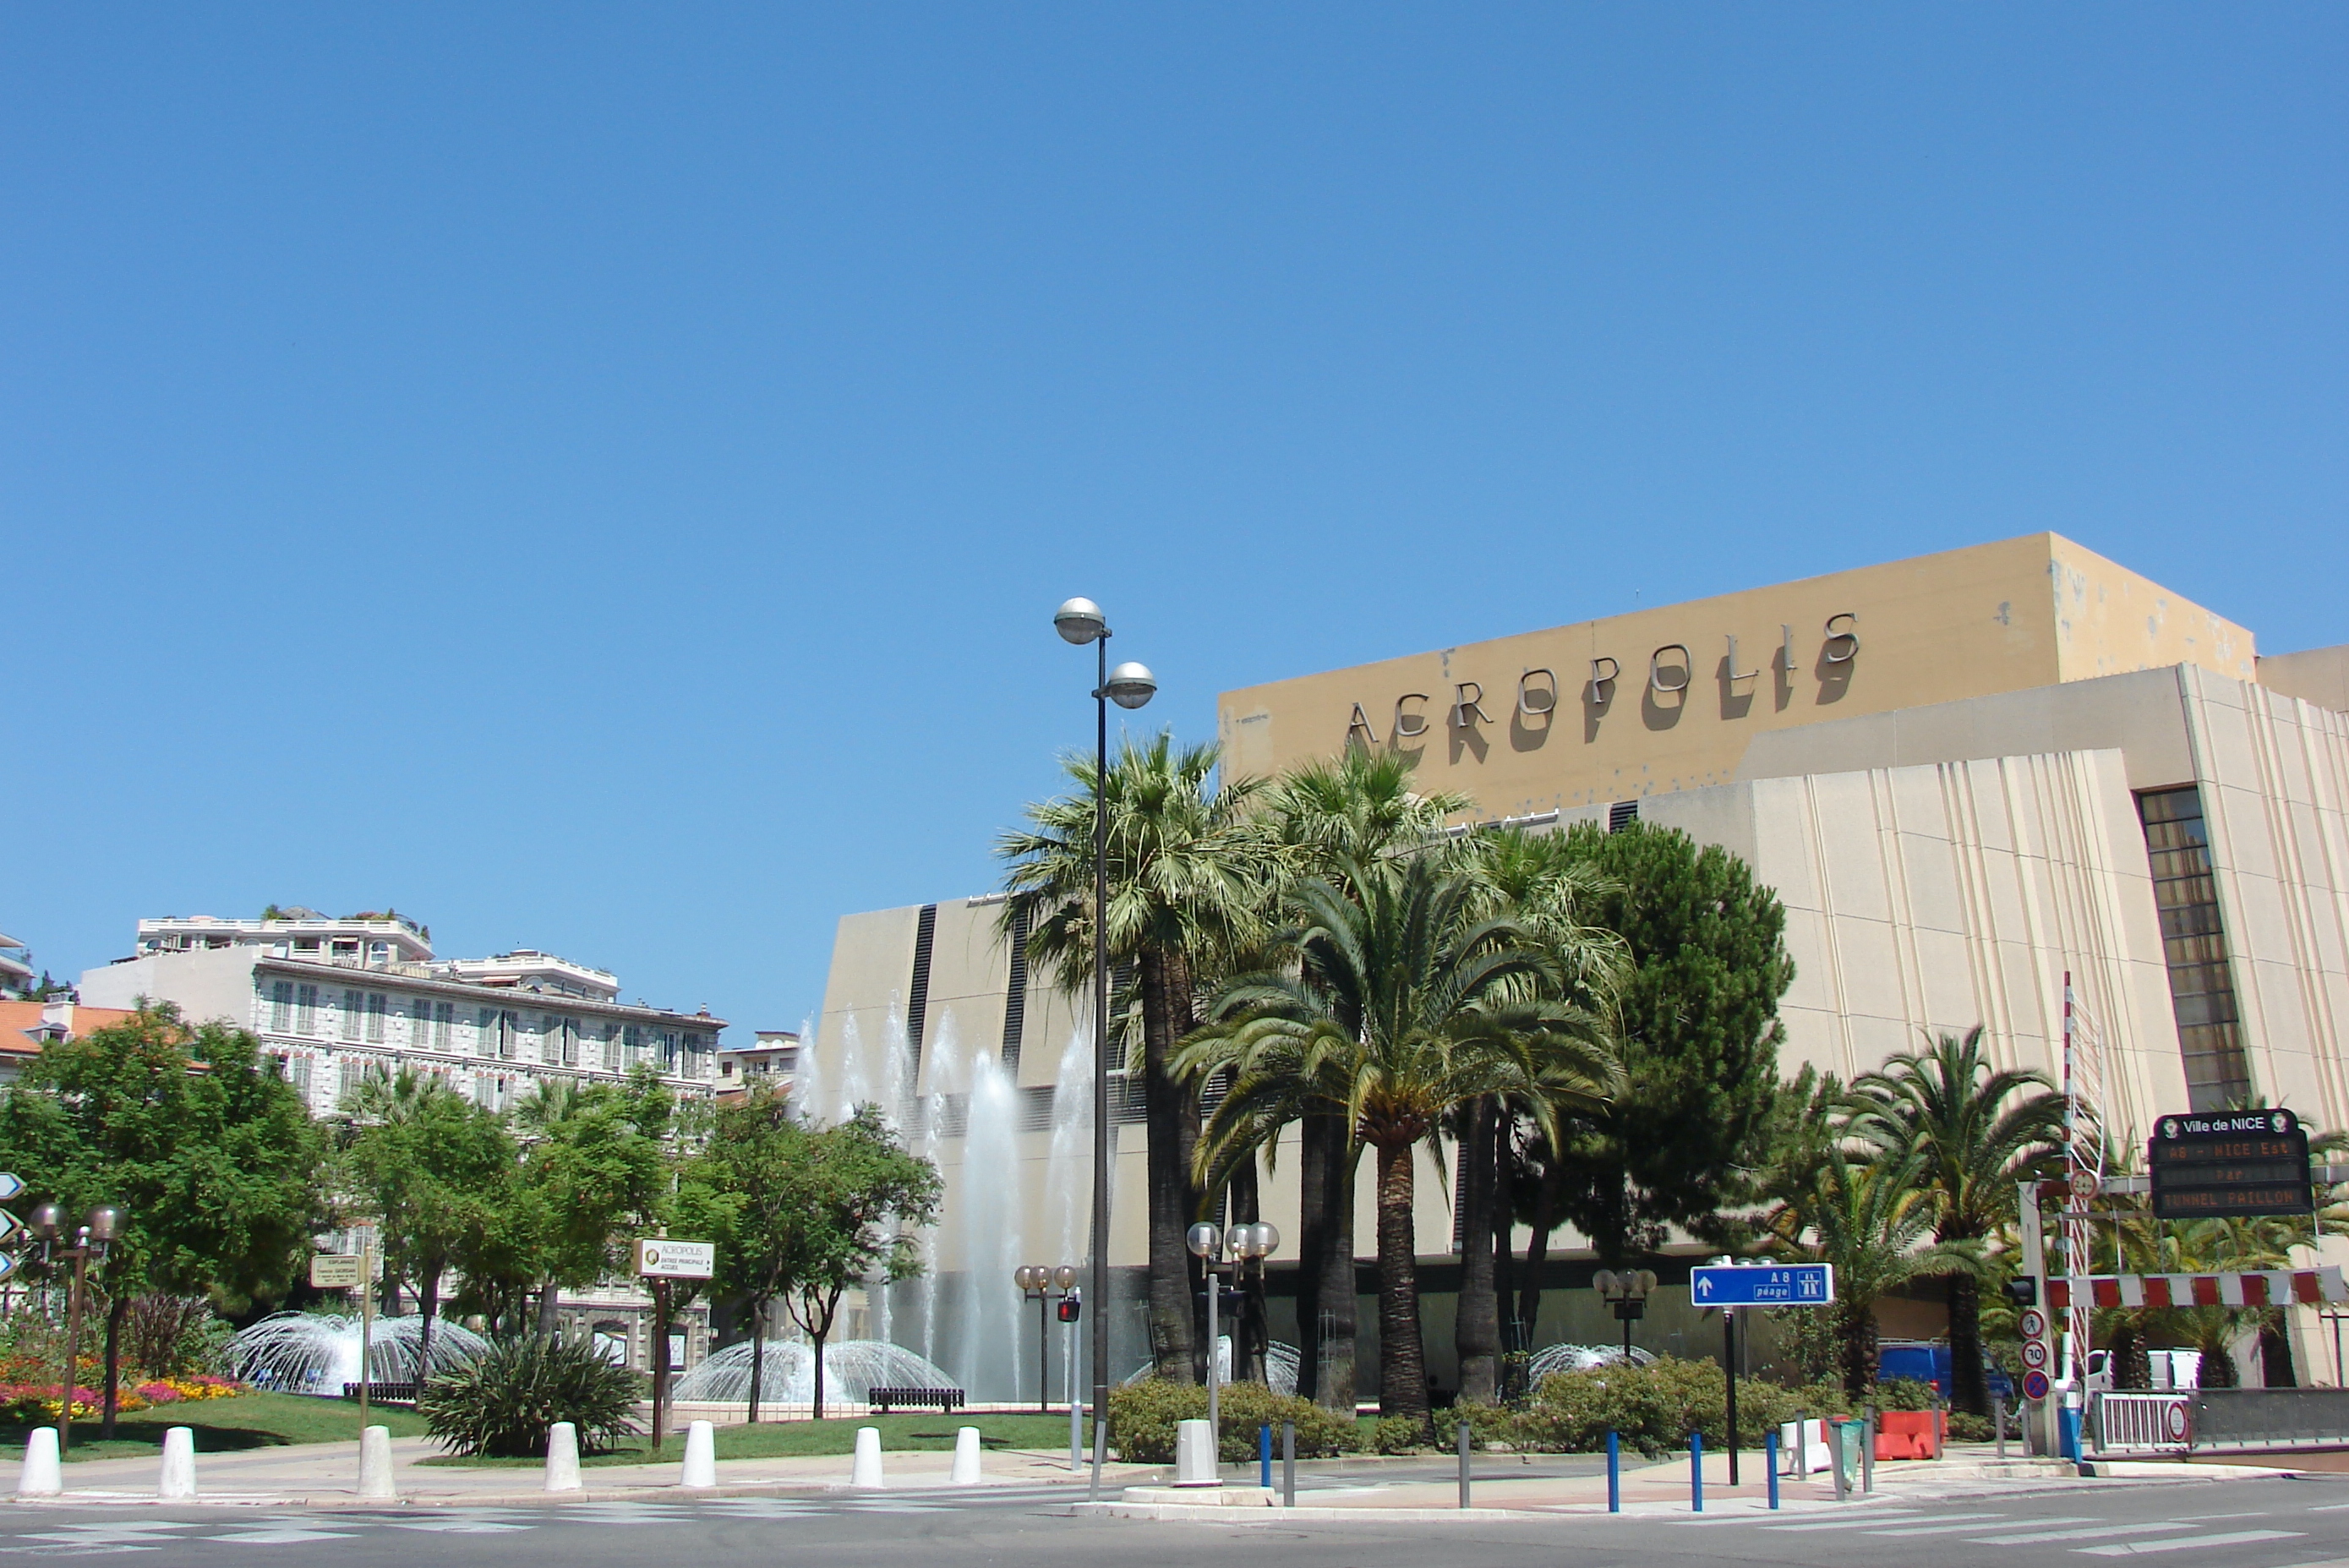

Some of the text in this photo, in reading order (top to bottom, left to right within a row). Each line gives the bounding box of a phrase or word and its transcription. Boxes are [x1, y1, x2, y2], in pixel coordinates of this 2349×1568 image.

[1344, 612, 1860, 743] ACROPOLIS
[2183, 1117, 2265, 1133] Ville de NICE
[2214, 1143, 2251, 1156] NICE
[2260, 1142, 2290, 1156] Est
[2165, 1191, 2294, 1206] TUNNEL PAILLON
[662, 1245, 703, 1256] ACROPOLIS
[1771, 1271, 1790, 1283] A 8
[1756, 1285, 1788, 1298] péage
[2028, 1349, 2041, 1360] 30
